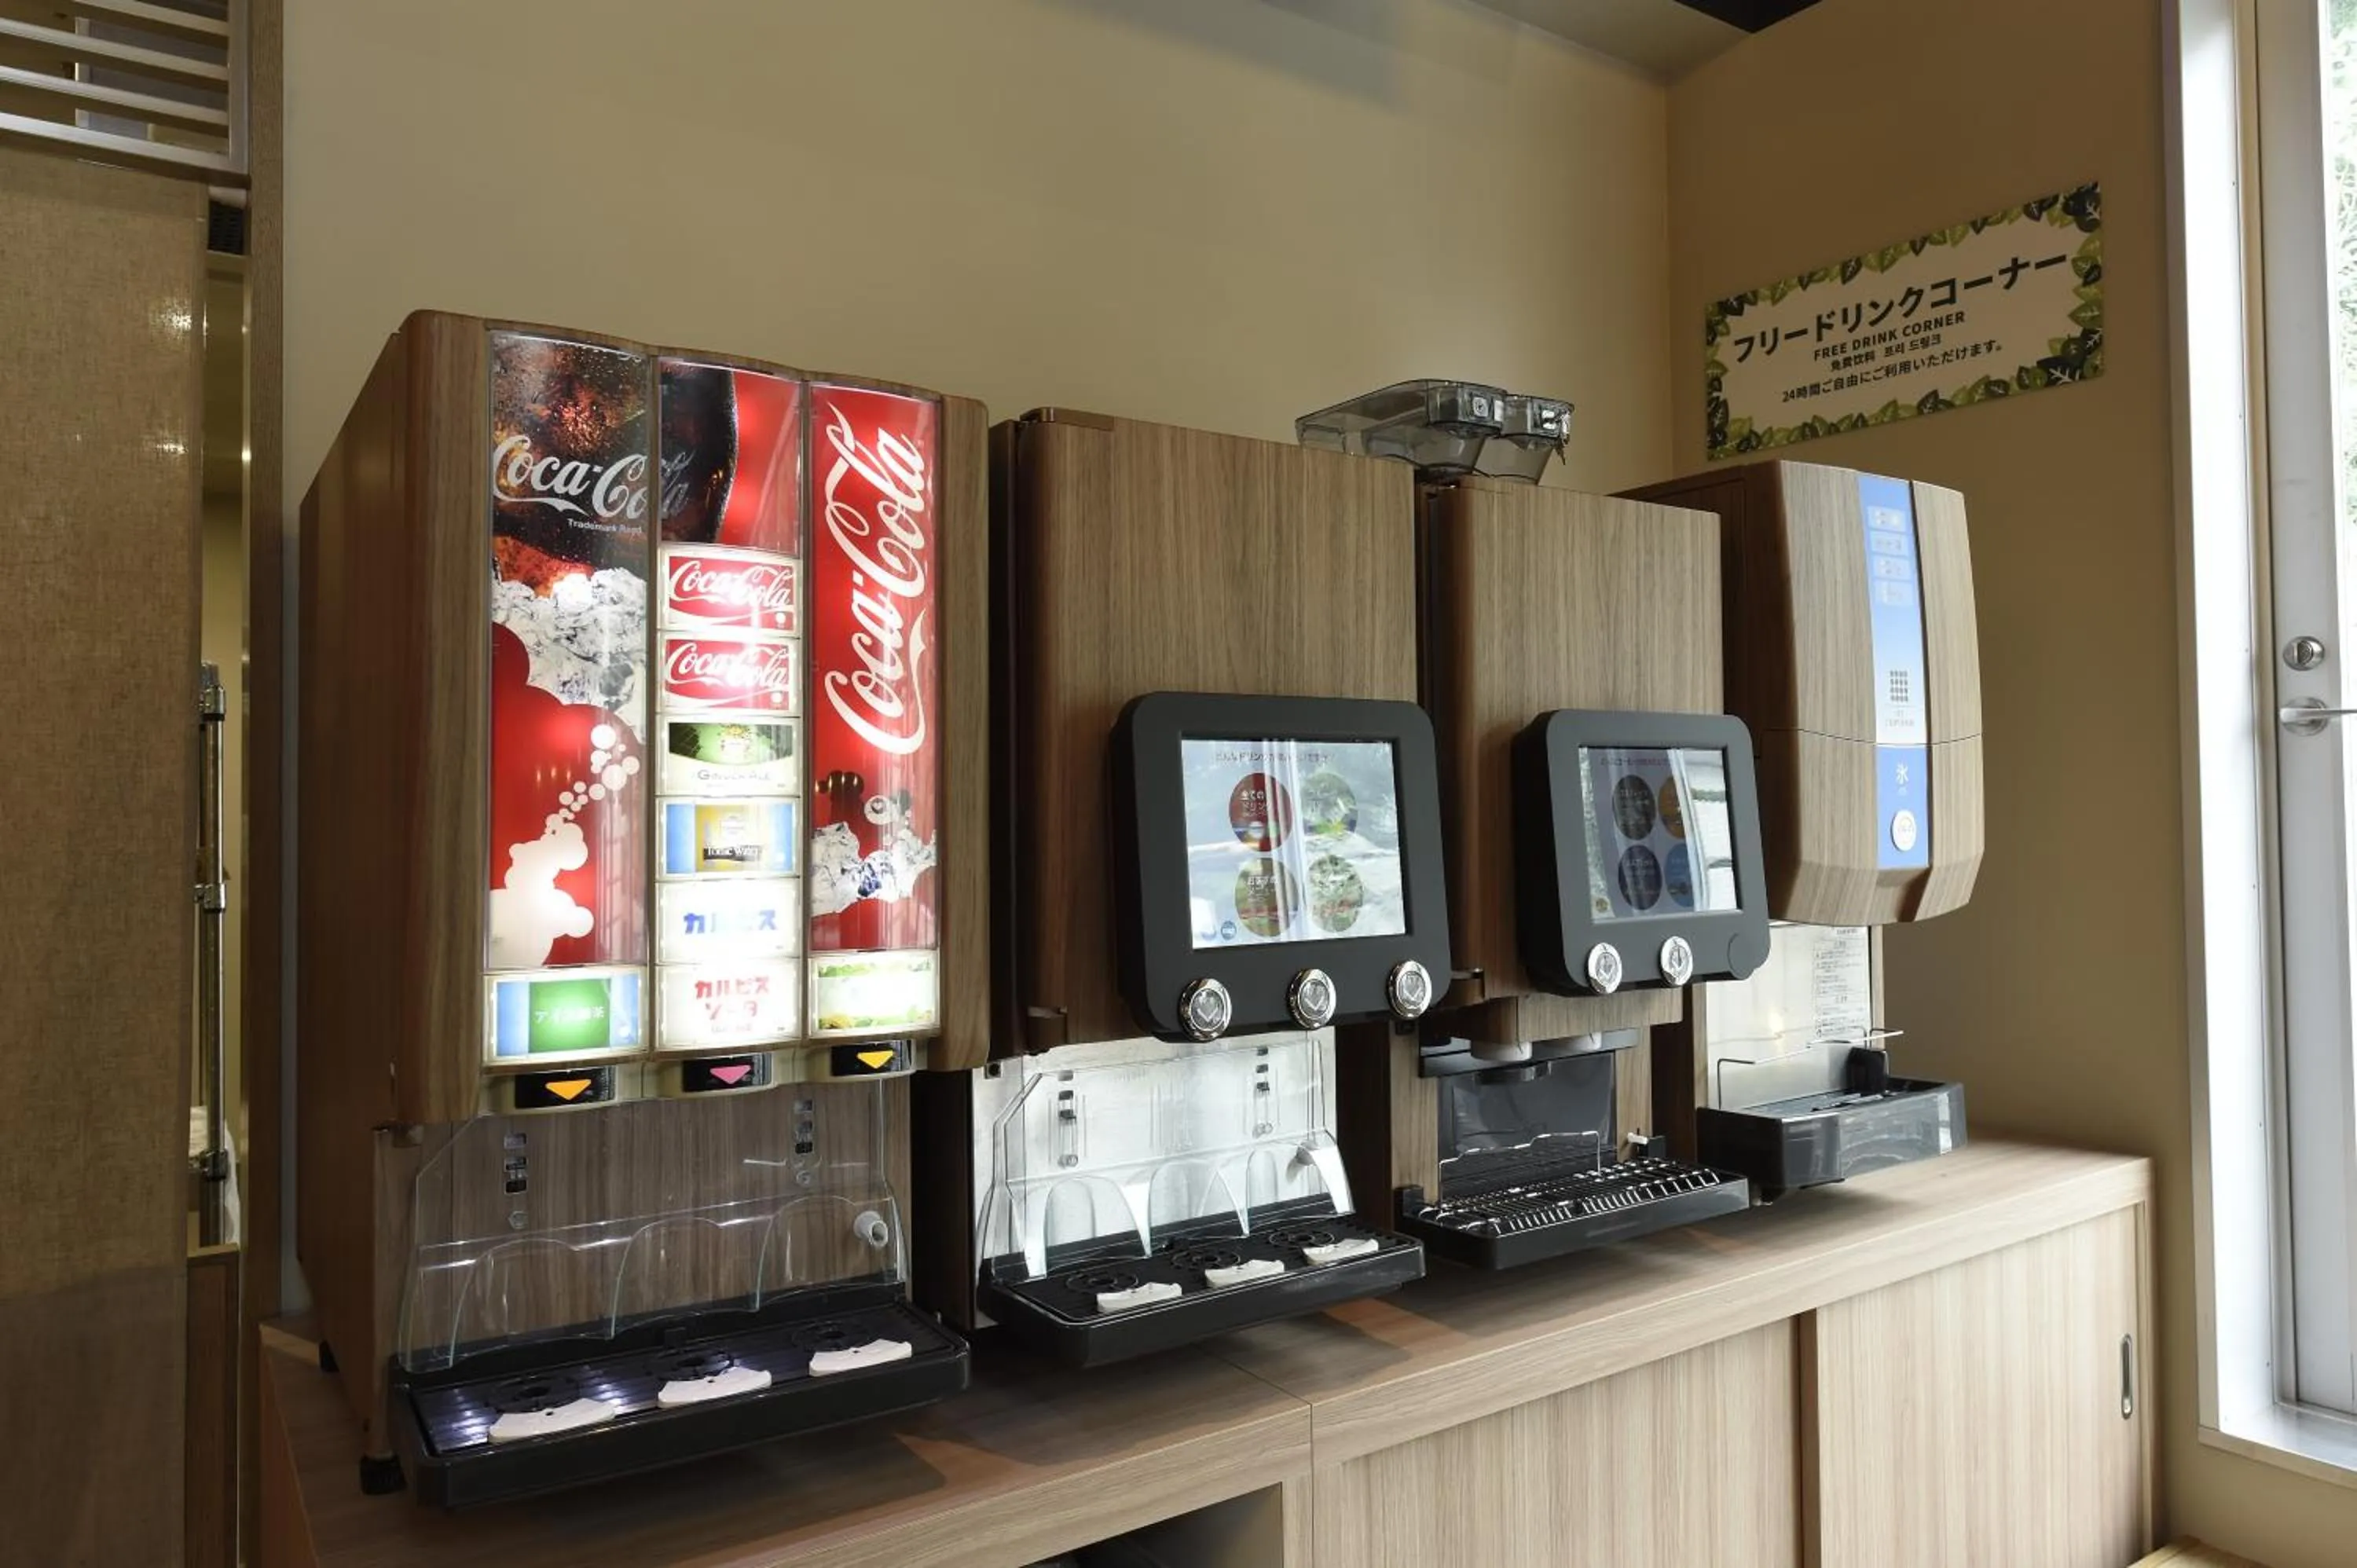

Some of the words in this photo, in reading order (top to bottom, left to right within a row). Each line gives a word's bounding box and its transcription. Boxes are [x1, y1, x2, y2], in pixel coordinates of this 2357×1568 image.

[1733, 254, 2067, 363] フリードリンクコーナー
[1813, 340, 1847, 361] FREE
[1852, 328, 1898, 351] DRINK
[1902, 311, 1966, 338] CORNER
[1781, 339, 2003, 403] 24時間ご自由にご利用いただけます。
[566, 518, 617, 533] Trademark
[669, 559, 793, 608] Coca-Cola
[825, 401, 926, 755] Coca-Cola
[665, 642, 790, 688] Coca-Cola
[1896, 763, 1910, 785] 氷
[683, 909, 778, 935] カス
[695, 975, 770, 999] カルピス
